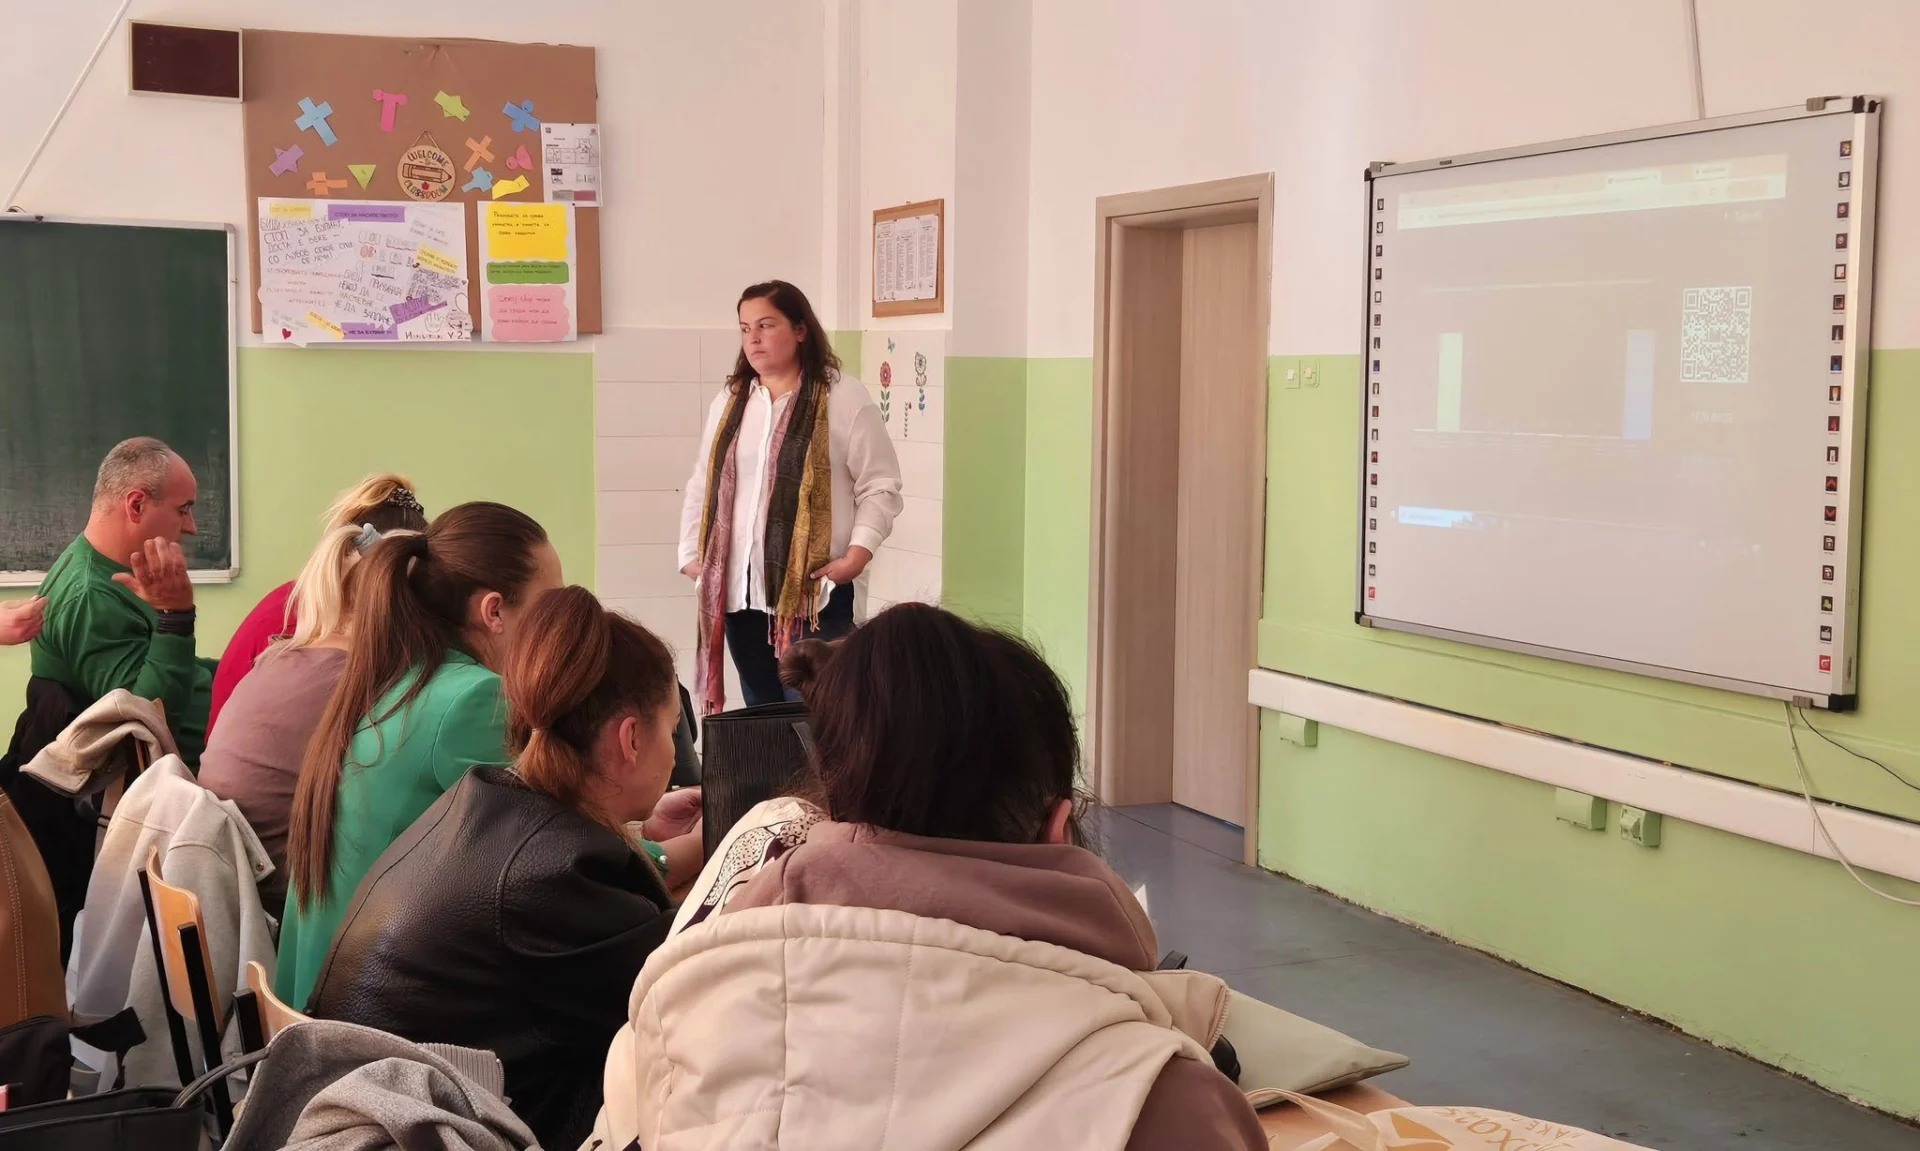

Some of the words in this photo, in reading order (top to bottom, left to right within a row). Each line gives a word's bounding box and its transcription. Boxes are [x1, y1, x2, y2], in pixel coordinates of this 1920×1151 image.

[407, 150, 449, 168] WELCOME
[404, 180, 448, 199] CLASSROOM
[263, 229, 289, 245] СТОП
[268, 255, 280, 265] СО
